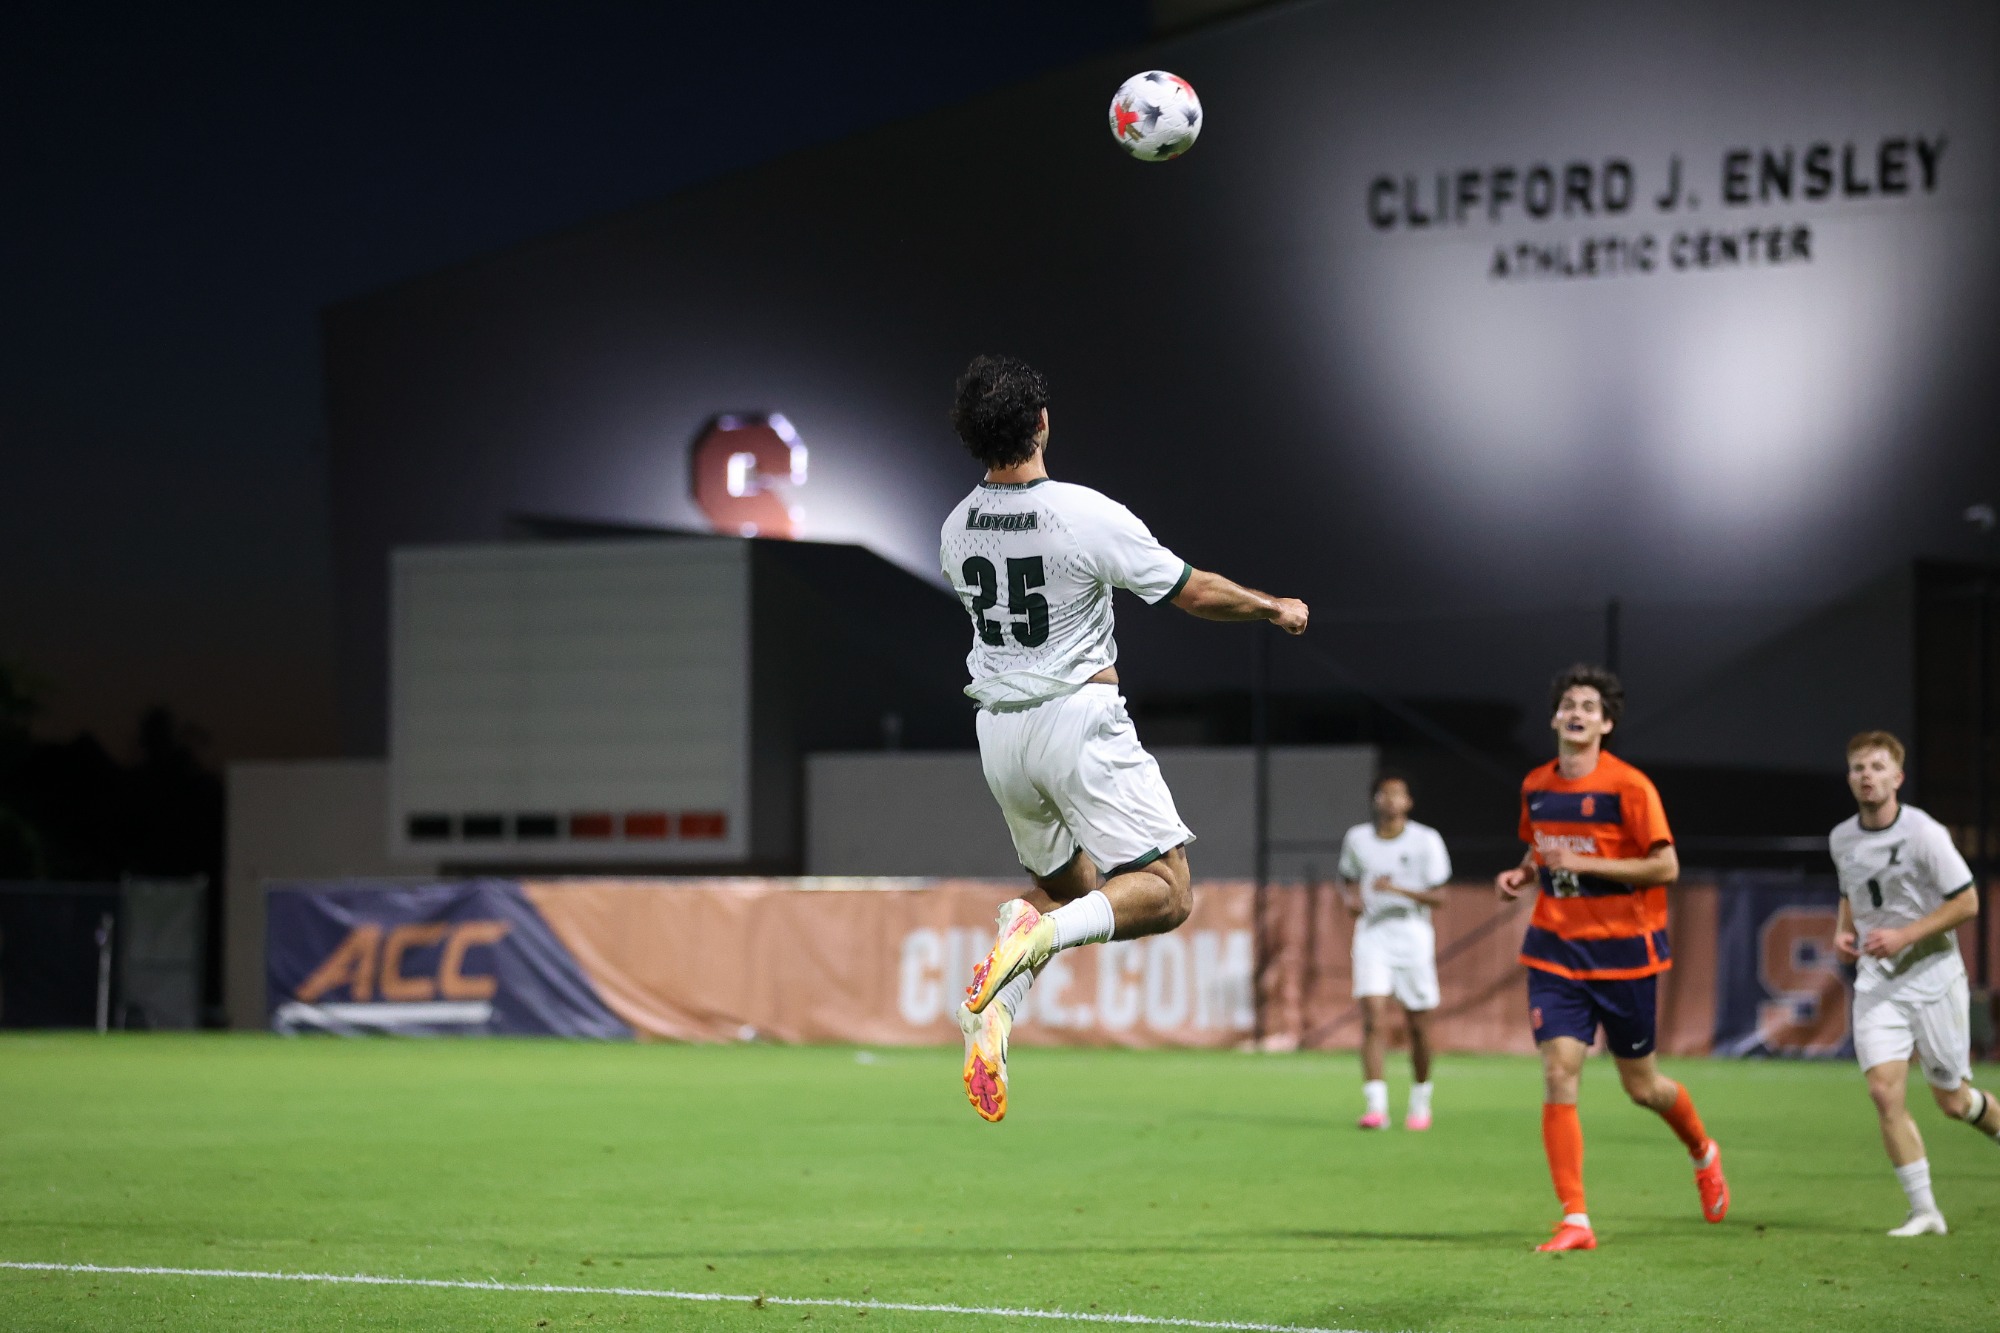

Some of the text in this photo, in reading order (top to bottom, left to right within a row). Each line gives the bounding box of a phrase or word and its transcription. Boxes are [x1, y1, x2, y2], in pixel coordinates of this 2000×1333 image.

[1367, 133, 1946, 230] CLIFFORD J. ENSLEY
[1490, 223, 1813, 280] ATHLETIC CENTER
[962, 556, 1049, 647] 25
[297, 922, 510, 1000] ACC
